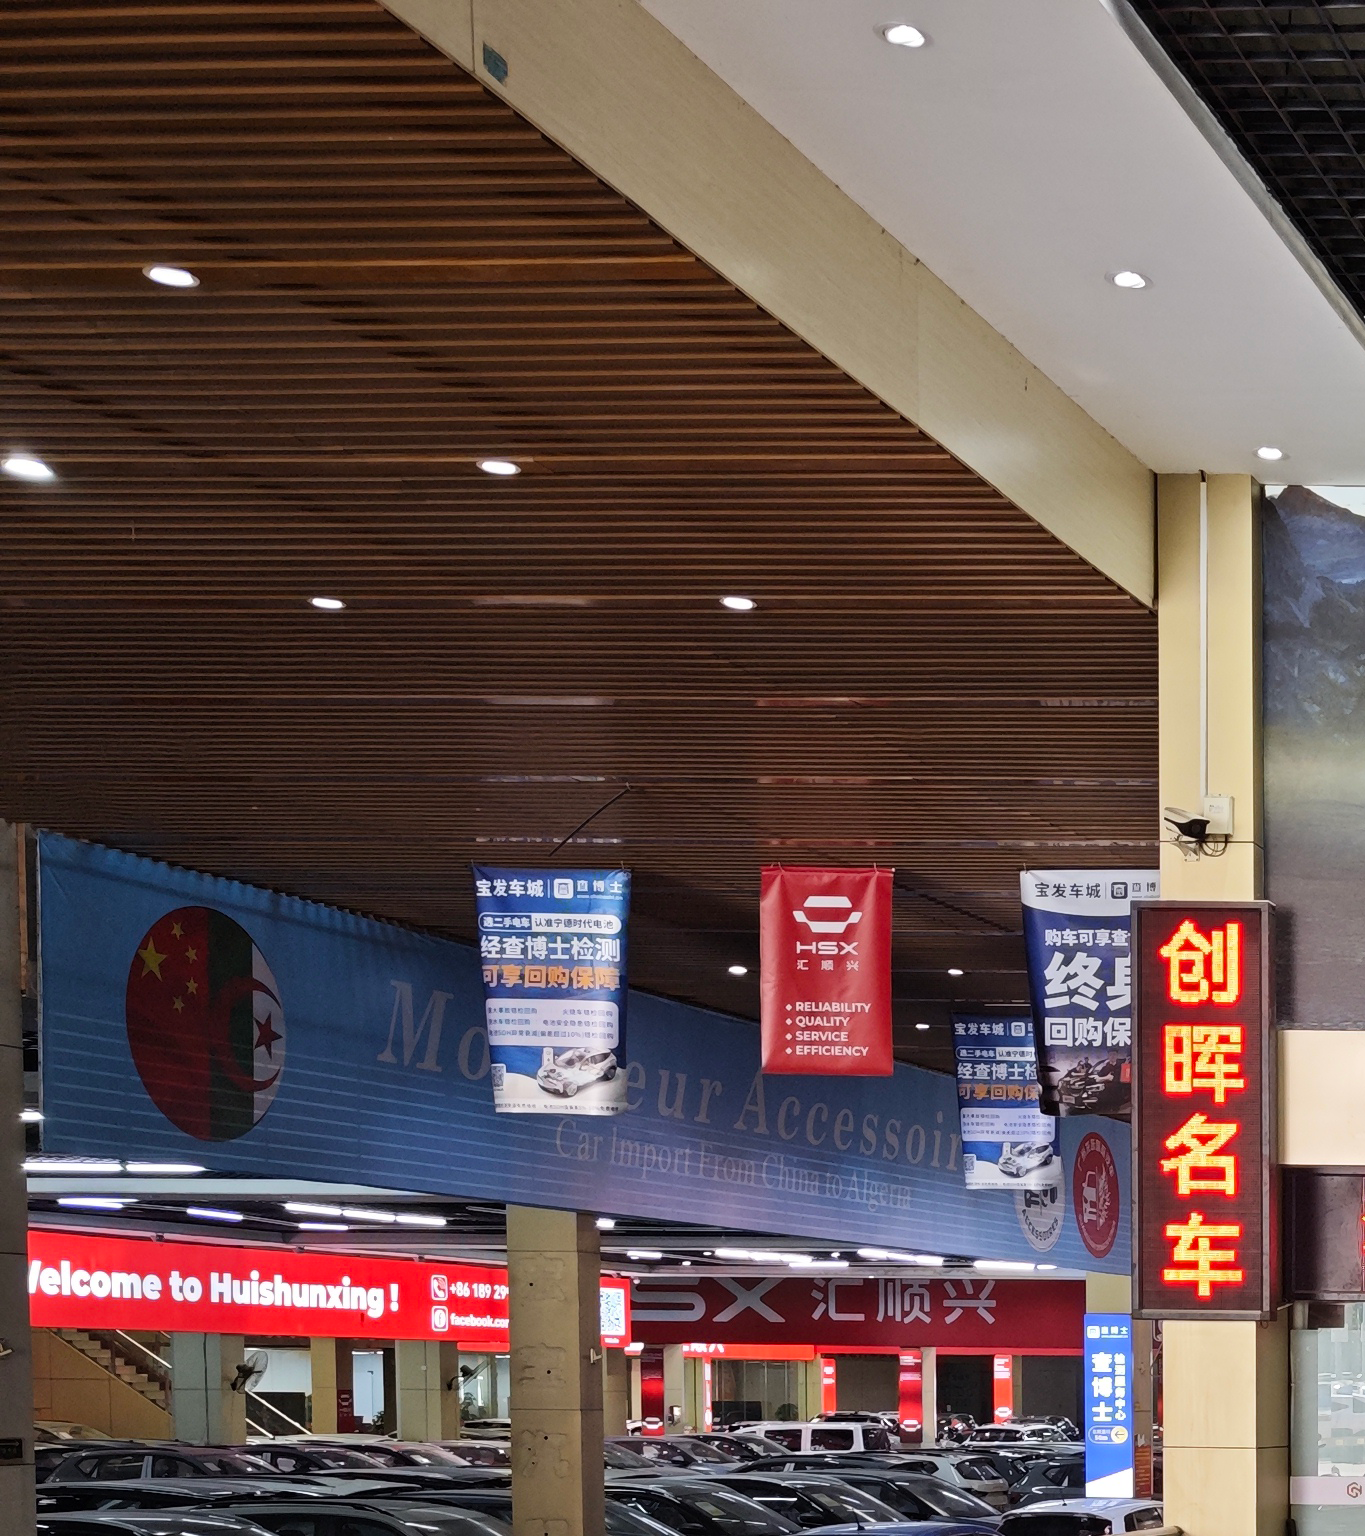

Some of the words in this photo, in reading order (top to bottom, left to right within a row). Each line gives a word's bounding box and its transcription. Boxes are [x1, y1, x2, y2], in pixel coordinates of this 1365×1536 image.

[476, 878, 544, 898] 宝发车城
[1035, 882, 1101, 899] 宝发车城
[480, 935, 621, 962] 经查博士检测
[796, 941, 859, 955] HSX
[797, 959, 860, 972] 汇顺兴
[482, 964, 621, 991] 可享回购保障
[795, 1001, 872, 1013] RELIABILITY
[795, 1016, 850, 1028] QUALITY
[954, 1022, 1005, 1036] 宝发车城
[795, 1031, 849, 1042] SERVICE
[1044, 1017, 1131, 1047] 回购保
[795, 1045, 869, 1057] EFFICIENCY
[1158, 918, 1246, 1299] 创晖名车
[556, 1117, 602, 1162] Car
[611, 1127, 690, 1179] Import
[699, 1141, 755, 1184] From
[761, 1152, 818, 1195] China
[169, 1270, 202, 1303] to
[210, 1270, 384, 1319] Huishunxing
[450, 1281, 471, 1298] +86
[472, 1284, 492, 1299] 189
[493, 1285, 509, 1300] 29
[811, 1278, 997, 1325] 汇顺兴
